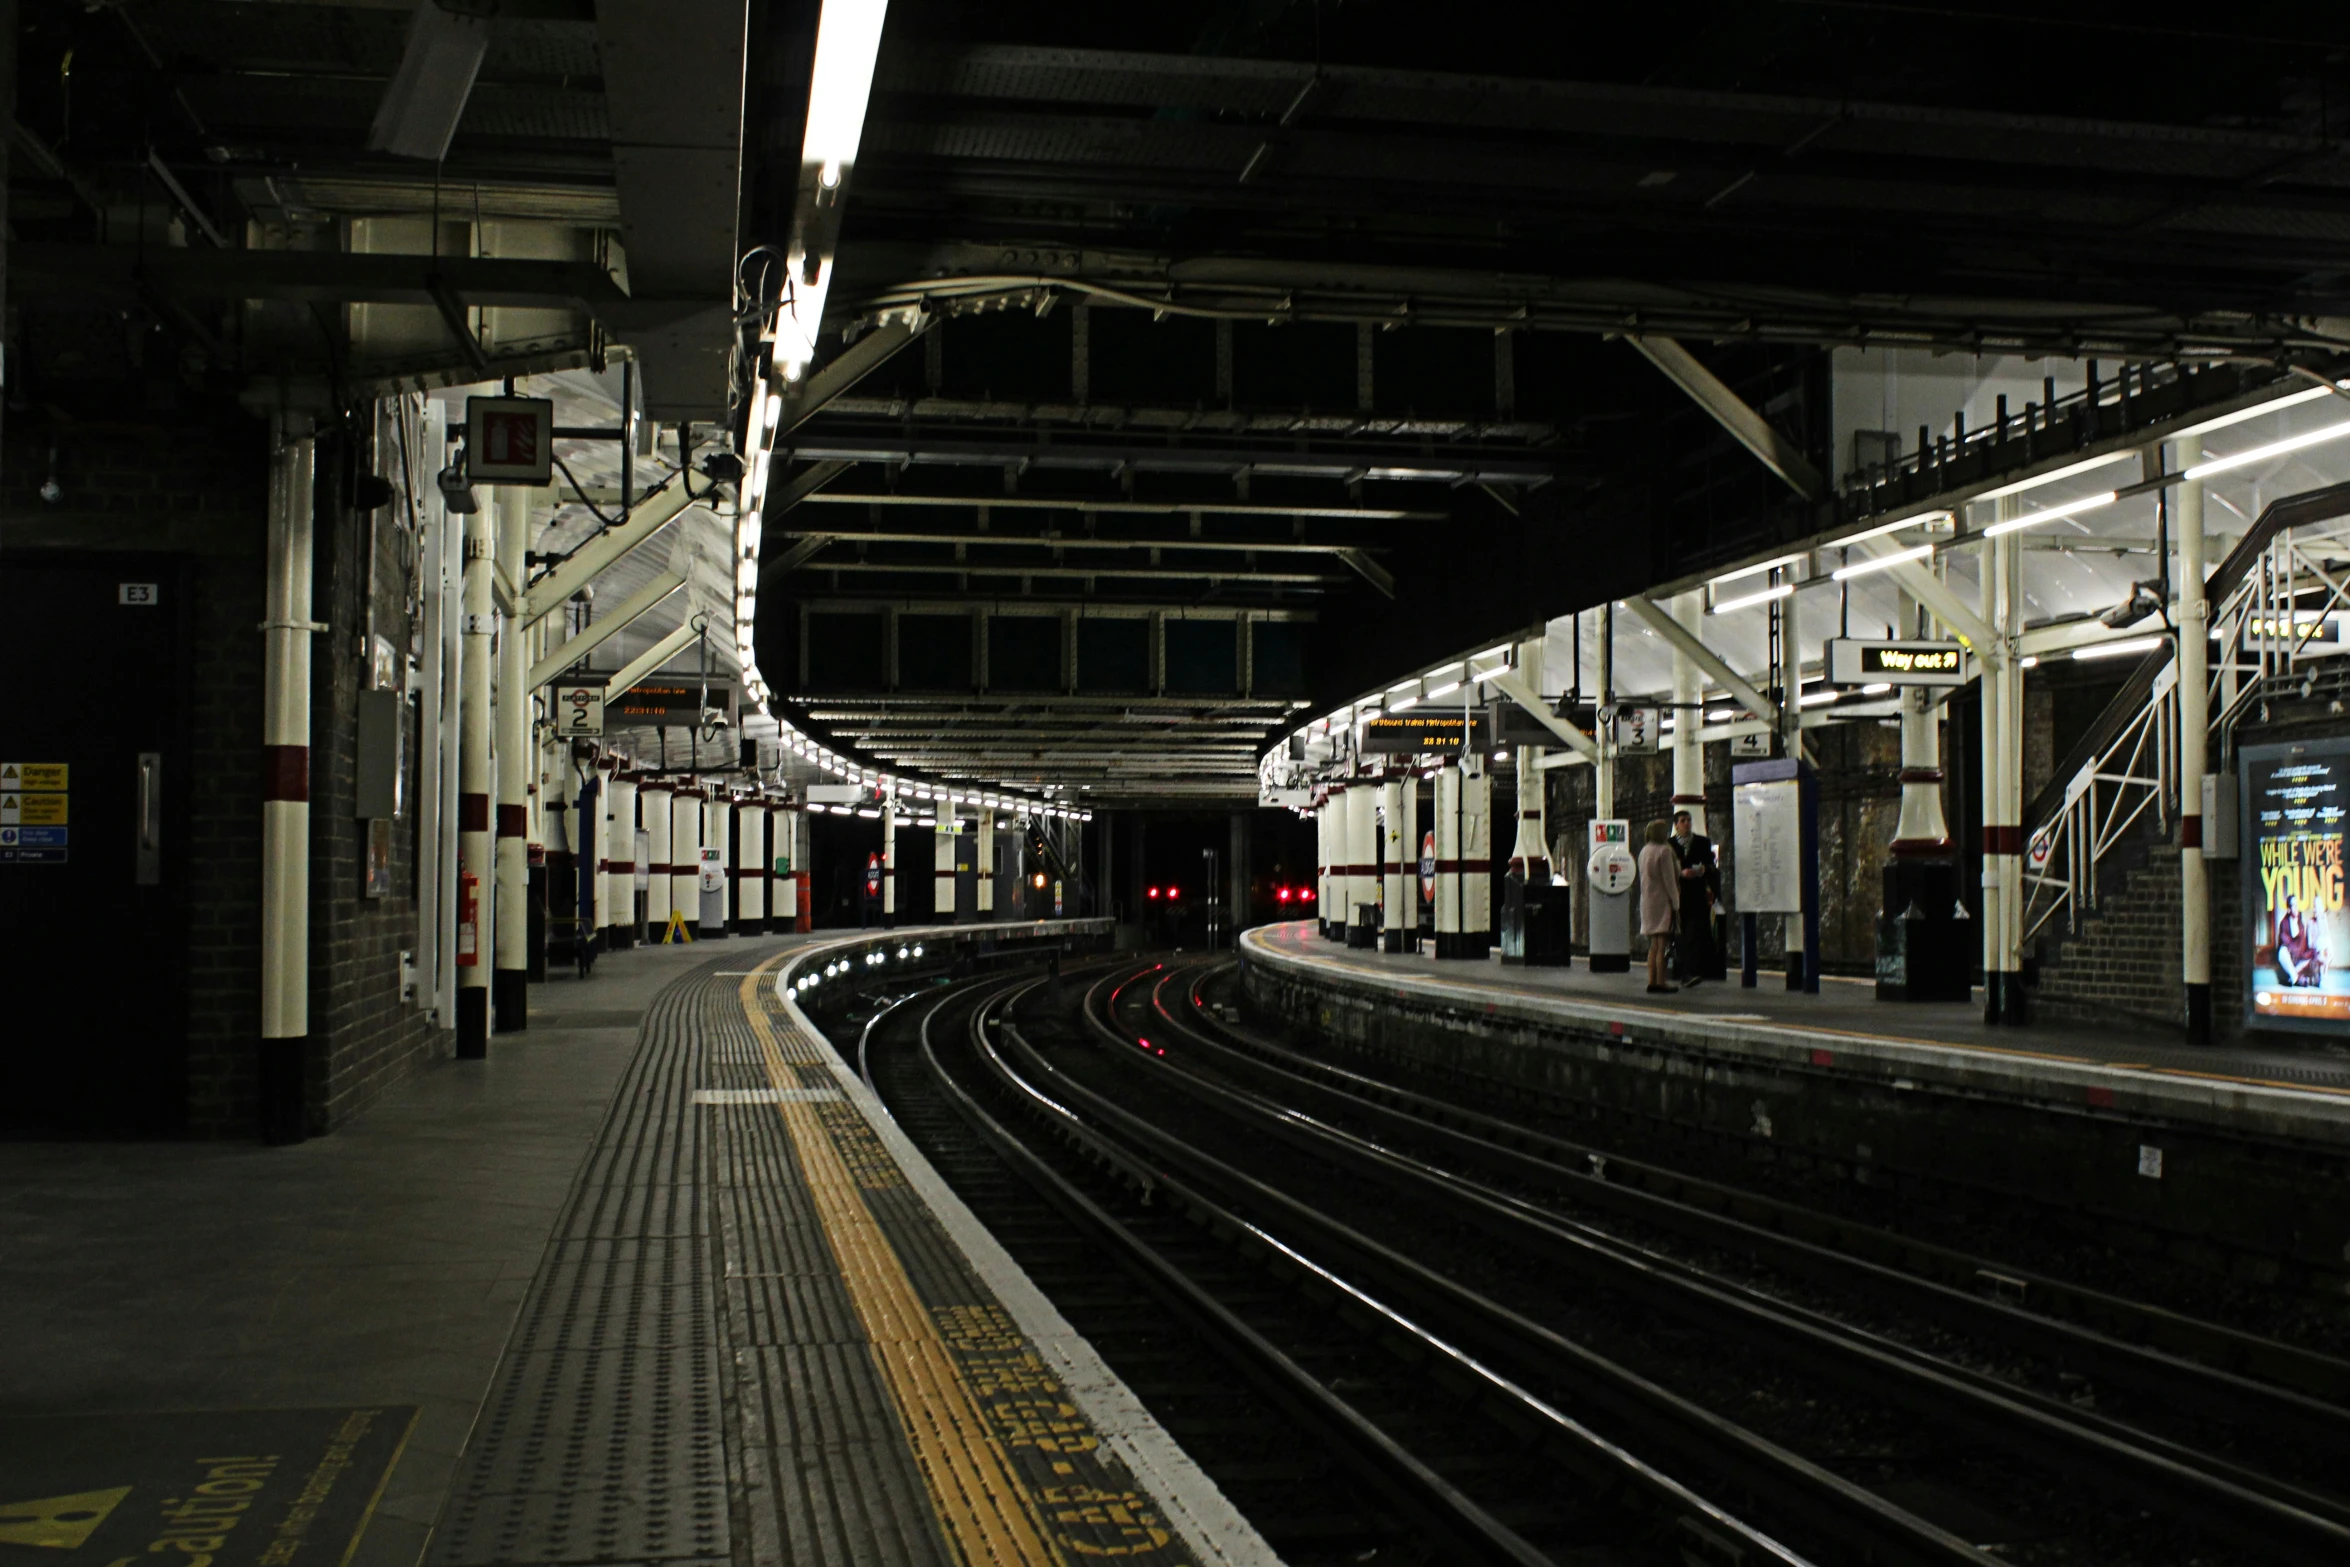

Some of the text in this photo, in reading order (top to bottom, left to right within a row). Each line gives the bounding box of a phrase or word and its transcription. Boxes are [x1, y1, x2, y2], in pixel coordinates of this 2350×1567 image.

[128, 586, 149, 601] E3
[1880, 650, 1942, 671] Way out
[573, 708, 588, 727] 2
[1632, 728, 1644, 745] 3
[1743, 733, 1758, 748] 4
[24, 766, 62, 779] Danger
[24, 797, 62, 806] Caution
[2261, 839, 2344, 867] WHILE WE'RE
[2261, 863, 2345, 913] YOUNG
